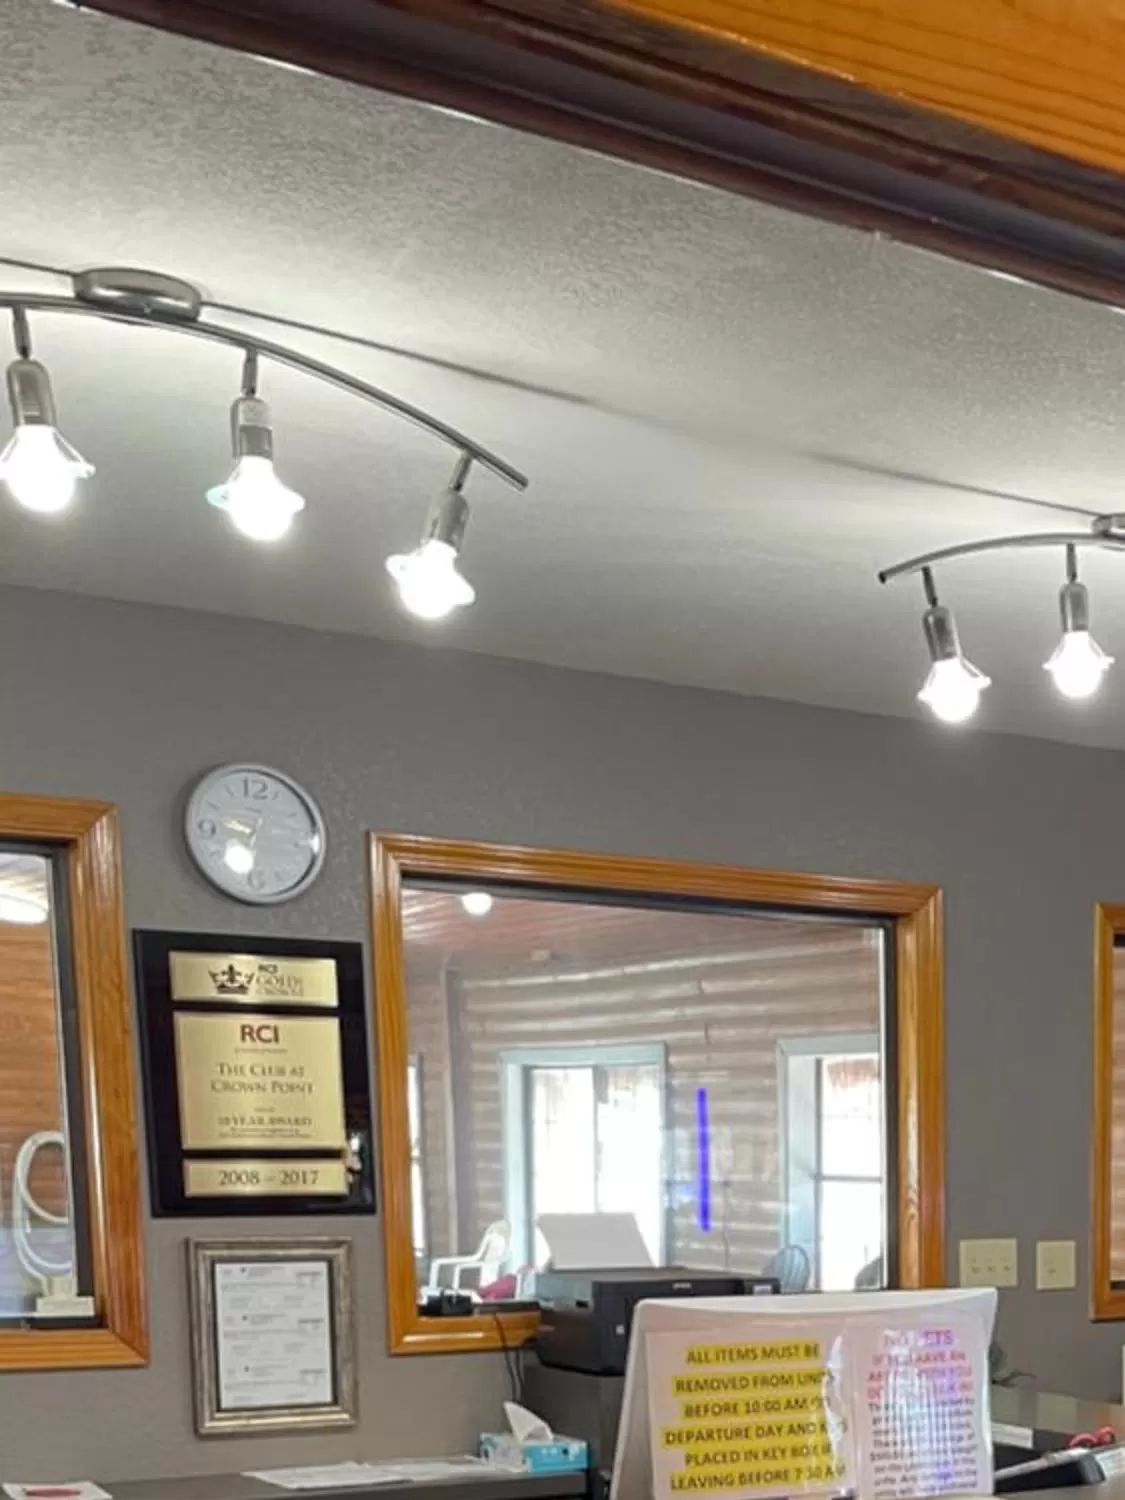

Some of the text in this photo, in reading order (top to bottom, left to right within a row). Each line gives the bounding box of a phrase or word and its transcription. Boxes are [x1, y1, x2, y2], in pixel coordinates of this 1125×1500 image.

[241, 776, 269, 800] 12
[197, 818, 216, 839] 9
[240, 1023, 280, 1044] RCI
[217, 1062, 246, 1077] THE
[249, 1063, 287, 1077] CLUB
[210, 1079, 314, 1096] CROWN POINT
[218, 1169, 260, 1186] 2008
[280, 1168, 320, 1186] 2017
[686, 1343, 820, 1365] ALL ITEMS MUST BE
[675, 1375, 749, 1393] REMOVED
[753, 1371, 795, 1389] FROM
[685, 1400, 739, 1419] BEFORE
[664, 1426, 751, 1446] DEPARTURE
[755, 1422, 783, 1438] DAY
[685, 1450, 740, 1467] PLACED
[744, 1448, 759, 1462] IN
[763, 1445, 787, 1460] KEY
[670, 1471, 736, 1491] LEAVING
[738, 1467, 790, 1486] BEFORE
